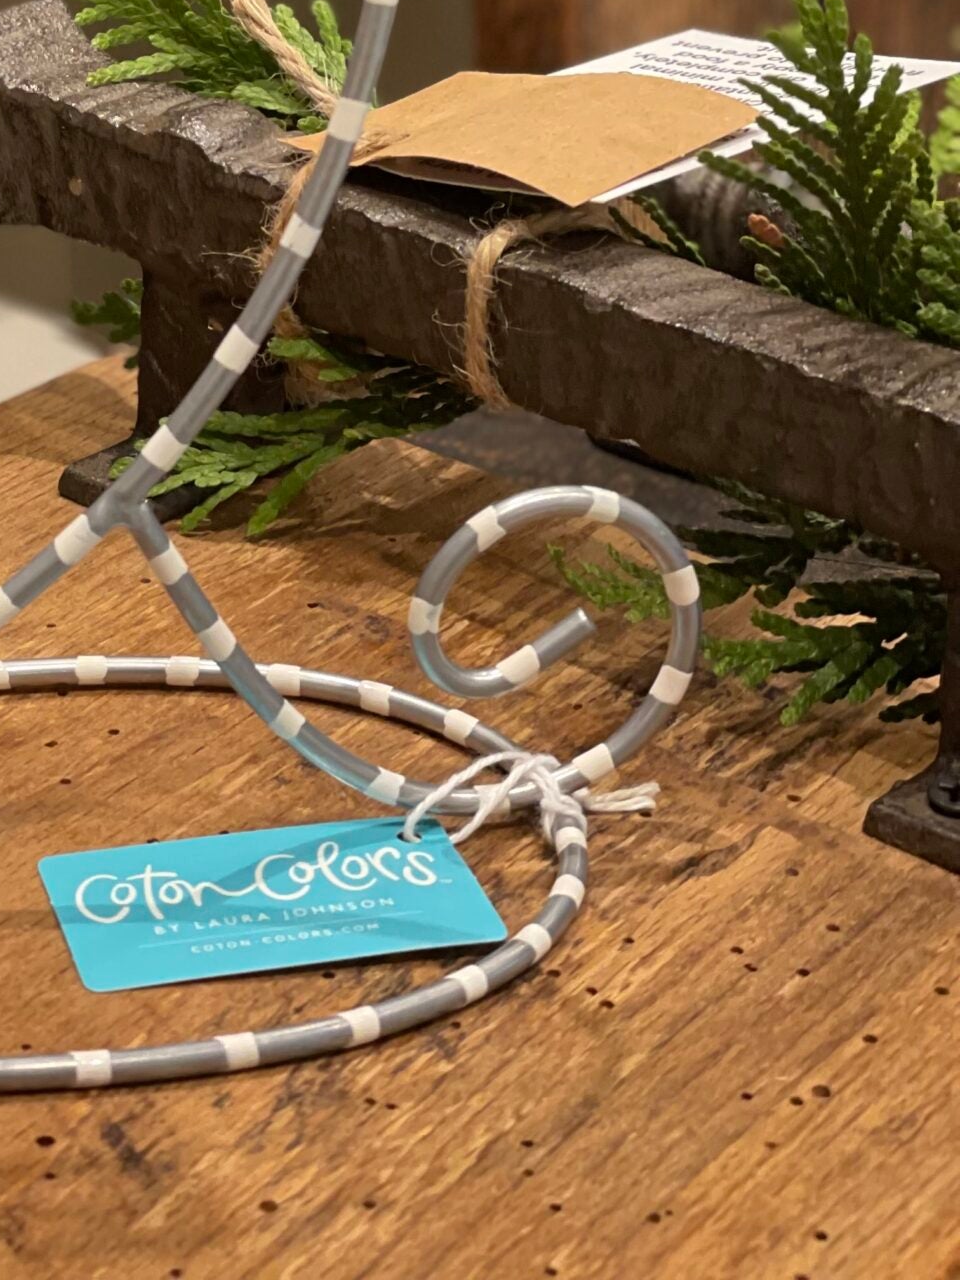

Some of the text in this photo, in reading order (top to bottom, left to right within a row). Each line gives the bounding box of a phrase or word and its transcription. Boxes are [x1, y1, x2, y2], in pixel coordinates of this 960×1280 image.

[671, 40, 767, 59] prevent
[672, 51, 729, 64] food
[629, 63, 725, 81] minimal
[75, 841, 437, 923] Coton Colors
[153, 897, 395, 936] BY LAURA JOHNSON
